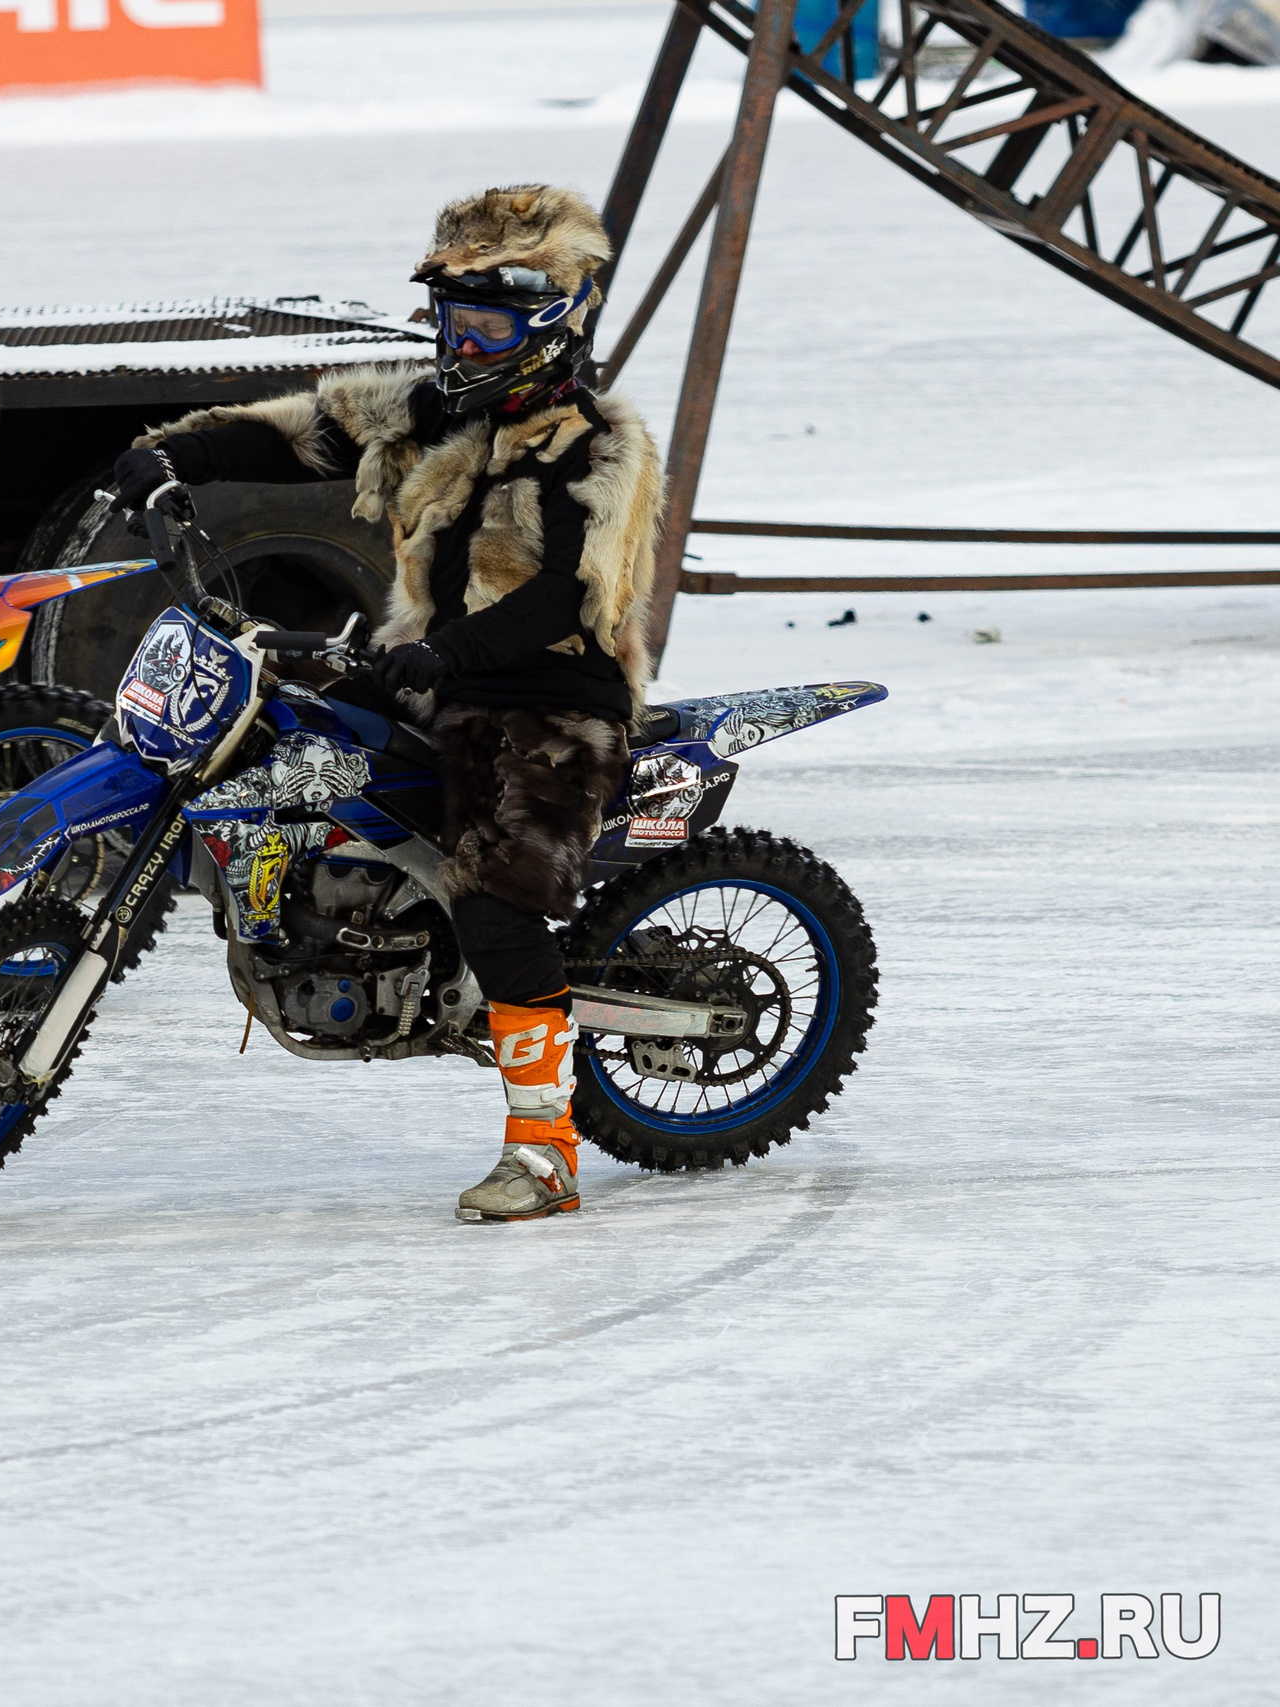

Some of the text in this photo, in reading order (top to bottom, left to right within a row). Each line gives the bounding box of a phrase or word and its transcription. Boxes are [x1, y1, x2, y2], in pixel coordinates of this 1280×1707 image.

[152, 449, 176, 480] SHO
[130, 681, 165, 707] ШКОЛА
[630, 829, 685, 837] МОТОКРОССА
[633, 819, 684, 831] ШКОЛА
[125, 852, 164, 907] CRAZY
